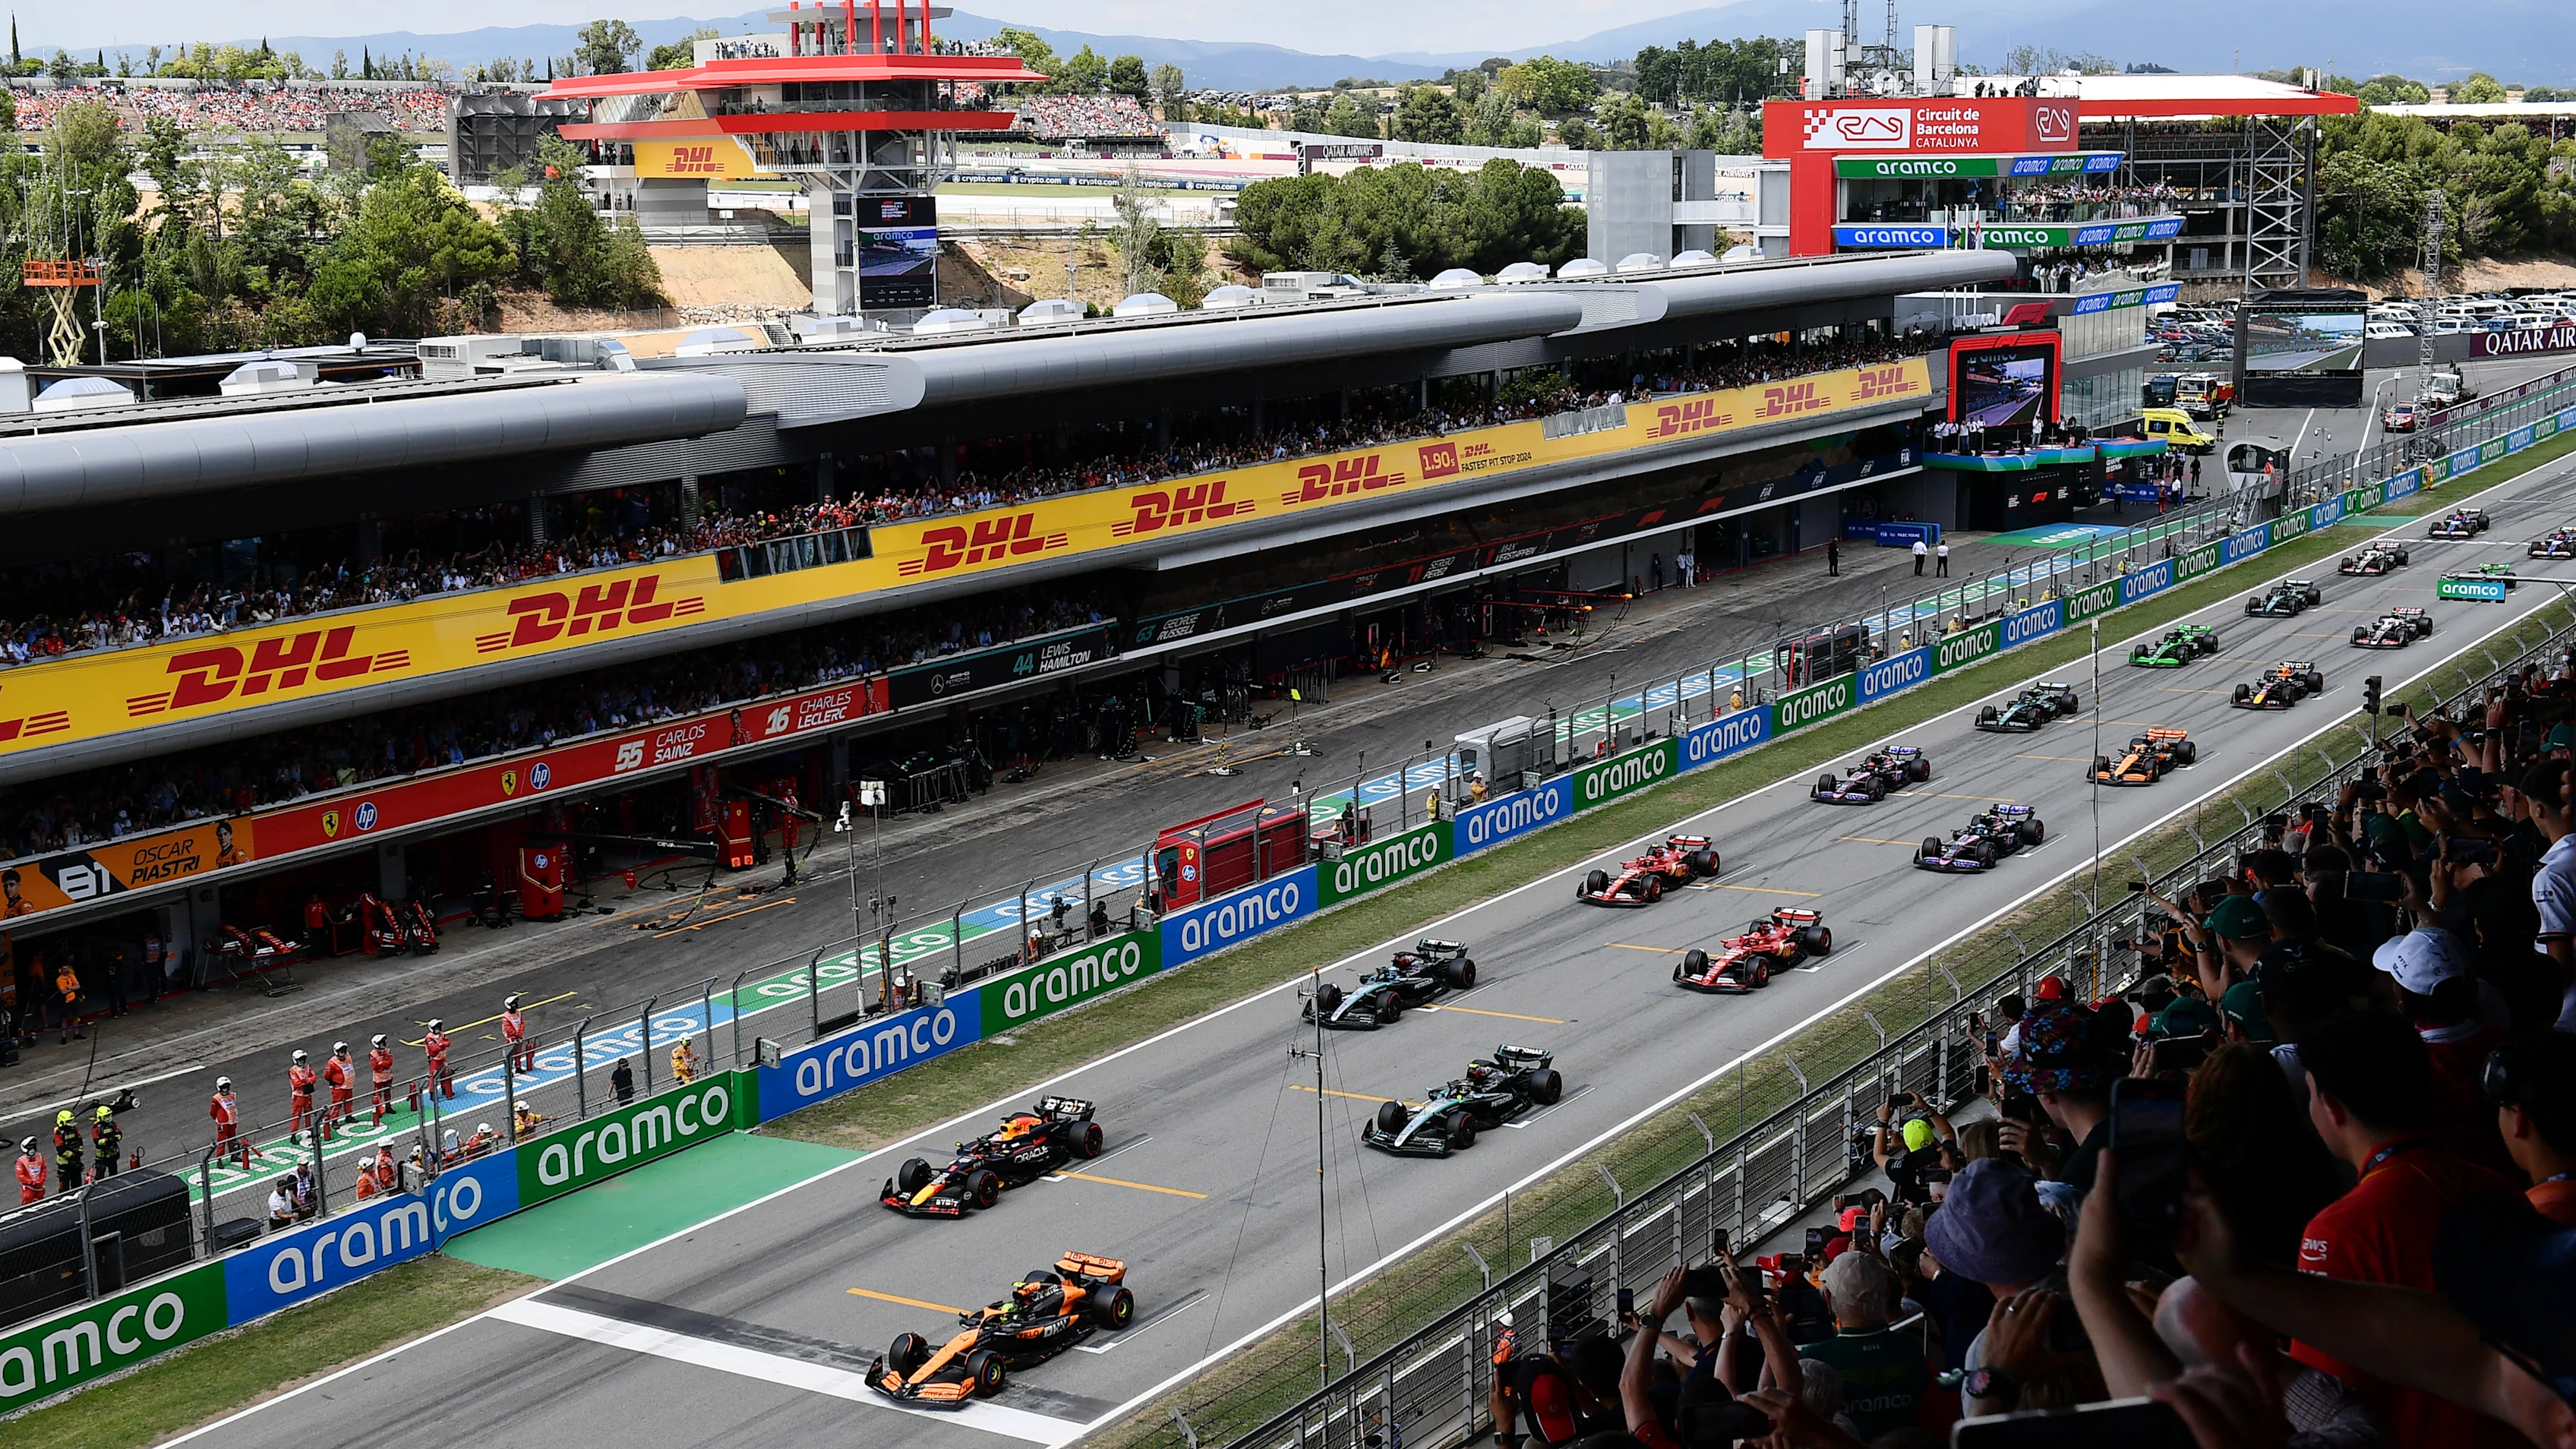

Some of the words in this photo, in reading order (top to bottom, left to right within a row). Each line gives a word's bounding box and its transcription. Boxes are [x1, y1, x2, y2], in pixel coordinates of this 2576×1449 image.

[1917, 109, 1960, 122] Circuit
[1962, 108, 1980, 122] de
[1916, 122, 1980, 135] Barcelona
[1322, 145, 1346, 157] QATAR
[1346, 144, 1375, 157] AIRWAYS
[1916, 137, 1979, 148] CATALUNYA
[673, 147, 717, 172] DHL
[1434, 158, 1457, 166] QATAR
[1876, 161, 1957, 175] aramco
[2014, 158, 2047, 173] aramco
[2051, 158, 2084, 172] aramco
[2087, 153, 2117, 169] aramco
[961, 175, 1003, 184] crypto.com
[1019, 176, 1062, 185] crypto.com
[1078, 178, 1120, 187] crypto.com
[1722, 169, 1754, 178] AIRWAYS
[1195, 182, 1238, 191] crypto.com
[873, 231, 914, 241] aramco
[1855, 230, 1934, 244] aramco
[1981, 230, 2049, 244] ramco
[2078, 228, 2111, 243] aramco
[2114, 223, 2146, 239] aramco
[2148, 220, 2178, 236] aramco
[2076, 296, 2109, 313] aramco
[2112, 291, 2143, 307] aramco
[2145, 285, 2176, 302] aramco
[1952, 312, 1996, 328] aramco
[2486, 329, 2544, 355] QATAR
[2547, 327, 2576, 349] AIR
[1858, 367, 1911, 397] DHL
[1763, 382, 1821, 416] DHL
[1659, 399, 1722, 437] DHL
[2534, 418, 2555, 439] aramco
[1464, 443, 1491, 458] DHL
[2481, 438, 2505, 462] aramco
[2508, 429, 2530, 450] aramco
[1461, 459, 1488, 472] FASTEST
[1489, 457, 1499, 466] PIT
[1500, 454, 1516, 466] STOP
[1517, 452, 1532, 462] 2024
[2422, 462, 2447, 485] amco
[2452, 450, 2477, 472] aramco
[1296, 454, 1390, 500] DHL
[2388, 473, 2415, 497] aramco
[1130, 480, 1239, 534] DHL
[2316, 499, 2340, 525] aram
[2273, 513, 2306, 541] aramco
[920, 513, 1047, 572] DHL
[1485, 548, 1496, 566] 1
[1498, 542, 1519, 554] MAX
[2229, 529, 2265, 558] aramco
[1406, 564, 1425, 584] 11
[2177, 547, 2217, 579] aramco
[2126, 565, 2167, 598] aramco
[2442, 583, 2499, 598] aramco
[507, 574, 676, 648] DHL
[2069, 586, 2114, 619] aramco
[1135, 624, 1154, 643] 63
[1163, 613, 1201, 630] GEORGE
[1157, 623, 1195, 642] RUSSELL
[2006, 607, 2056, 642] aramco
[1012, 653, 1034, 676] 44
[1040, 642, 1072, 661] LEWIS
[1939, 628, 1994, 668] aramco
[166, 625, 374, 709] DHL
[1039, 650, 1091, 673] HAMILTON
[1863, 655, 1923, 696] aramco
[765, 705, 791, 736] 16
[800, 690, 854, 715] CHARLES
[1781, 683, 1847, 727] aramco
[797, 706, 848, 730] LECLERC
[614, 740, 646, 773] 55
[655, 724, 707, 748] CARLOS
[1688, 712, 1762, 761] aramco
[653, 742, 695, 764] SAINZ
[1584, 747, 1667, 800] aramco
[1467, 787, 1559, 844] aramco
[58, 860, 111, 901] 81
[133, 838, 194, 867] OSCAR
[130, 854, 201, 886] PIASTRI
[1334, 831, 1438, 894] aramco
[1180, 882, 1300, 953] aramco
[1426, 939, 1460, 947] PETRONAS
[756, 933, 952, 998] aramco
[1002, 940, 1141, 1019] aramco
[466, 1016, 699, 1095] aramco
[794, 1008, 957, 1097] aramco
[1505, 1045, 1543, 1055] PETRONAS
[1491, 1093, 1514, 1108] PETRONAS
[537, 1084, 730, 1187] aramco
[187, 1121, 389, 1188] amco
[1014, 1145, 1049, 1163] ORACLE
[936, 1198, 959, 1208] BYBIT
[267, 1175, 483, 1296] aramco
[2301, 1237, 2328, 1253] aws
[0, 1291, 185, 1399] amco
[1862, 1343, 1881, 1352] BOSS
